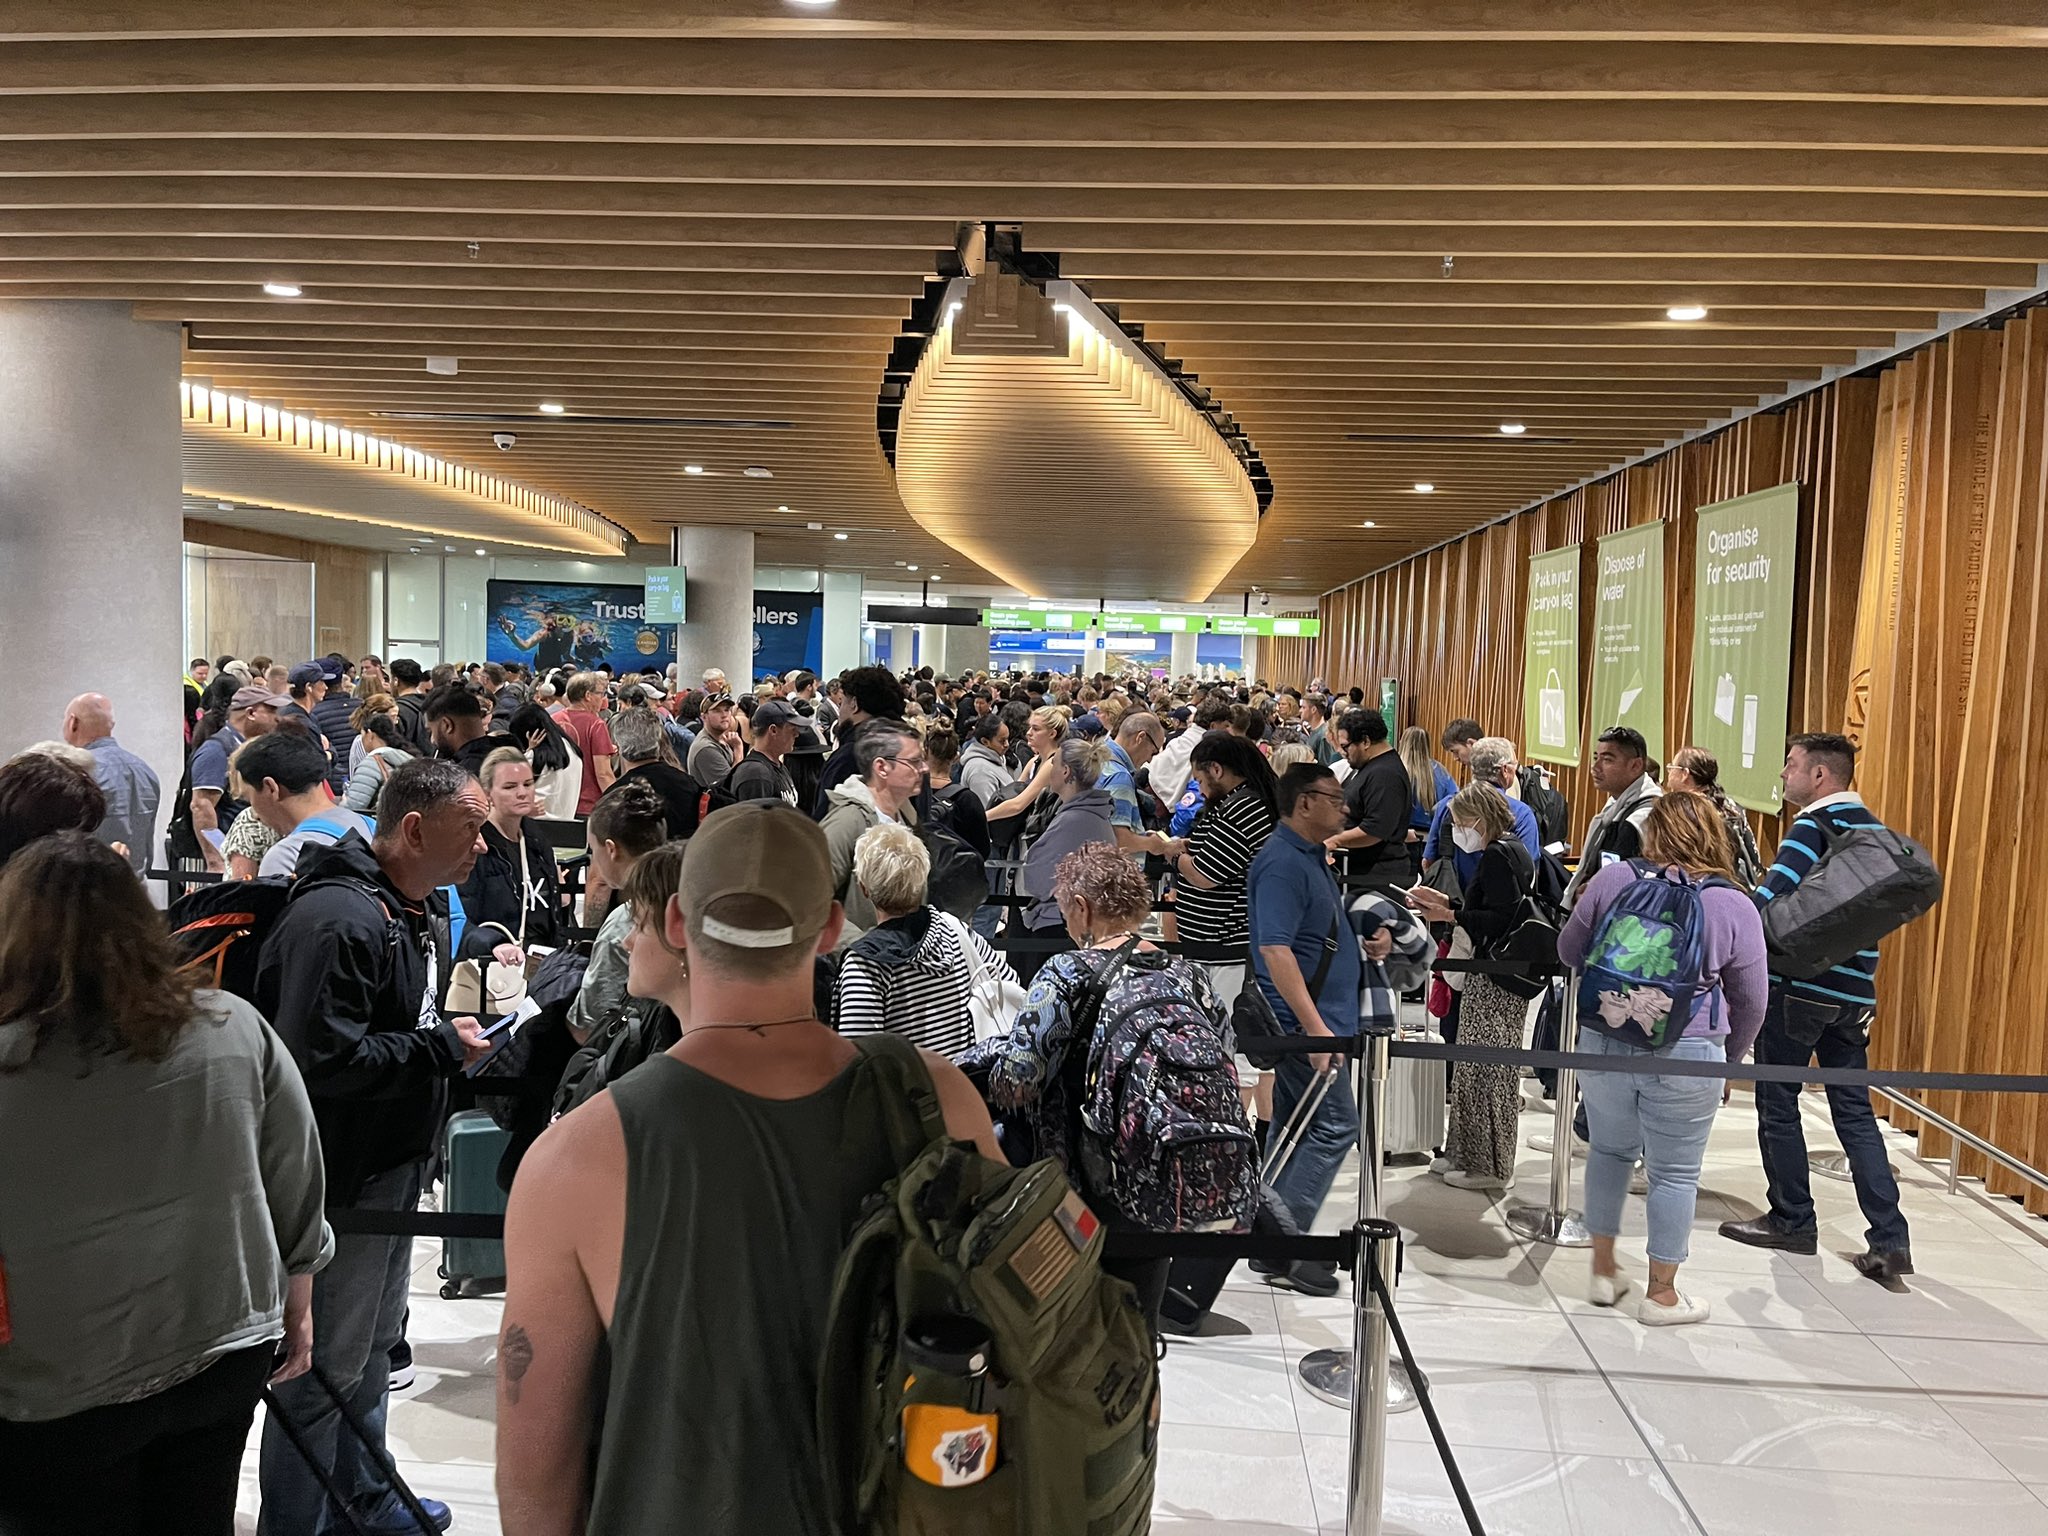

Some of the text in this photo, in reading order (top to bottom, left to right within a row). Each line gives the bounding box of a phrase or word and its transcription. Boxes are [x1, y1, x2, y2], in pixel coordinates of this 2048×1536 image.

[1977, 414, 1990, 437] THE
[1973, 441, 1987, 490] HANDLE
[1973, 494, 1985, 509] OF
[1970, 512, 1983, 535] THE
[1708, 523, 1759, 557] Organise
[1604, 547, 1646, 577] Dispose of
[1707, 553, 1771, 585] for security
[1967, 540, 1981, 585] PADDLE
[1535, 571, 1551, 588] Pack
[1602, 583, 1626, 601] water
[1966, 591, 1978, 602] IS
[752, 606, 799, 625] llers
[1962, 606, 1977, 648] LIFTED
[1961, 652, 1973, 666] TO
